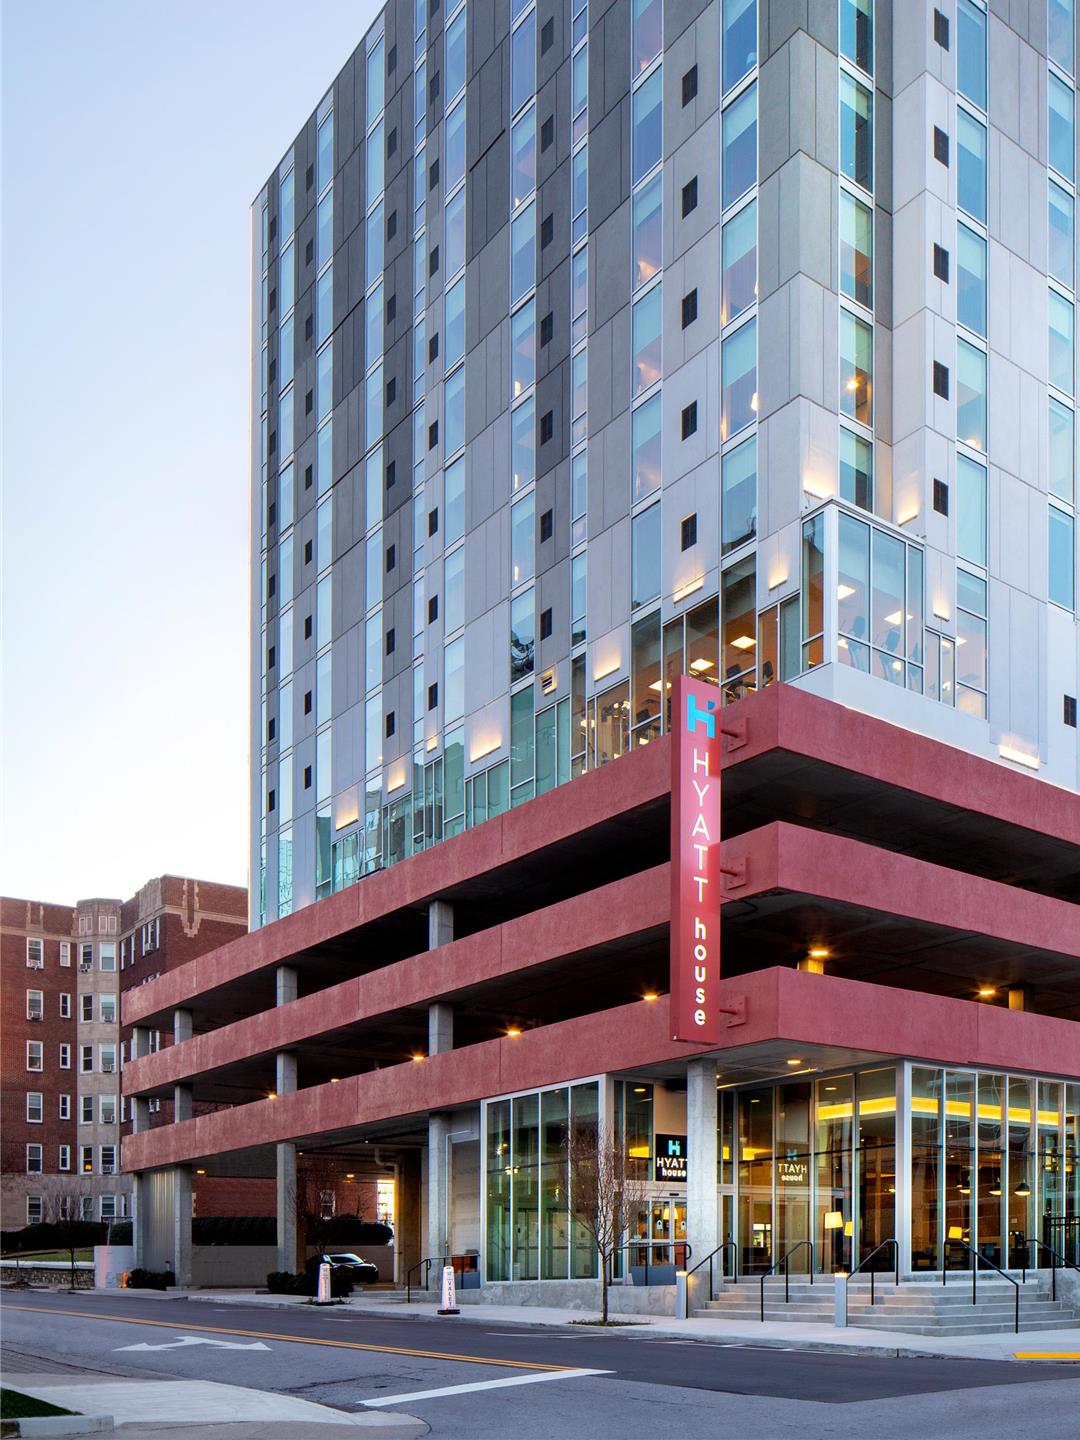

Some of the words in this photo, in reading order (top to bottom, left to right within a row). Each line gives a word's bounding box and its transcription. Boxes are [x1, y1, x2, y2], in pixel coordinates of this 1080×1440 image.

[691, 748, 709, 903] HYATT
[694, 916, 707, 1026] house
[662, 1167, 687, 1177] house
